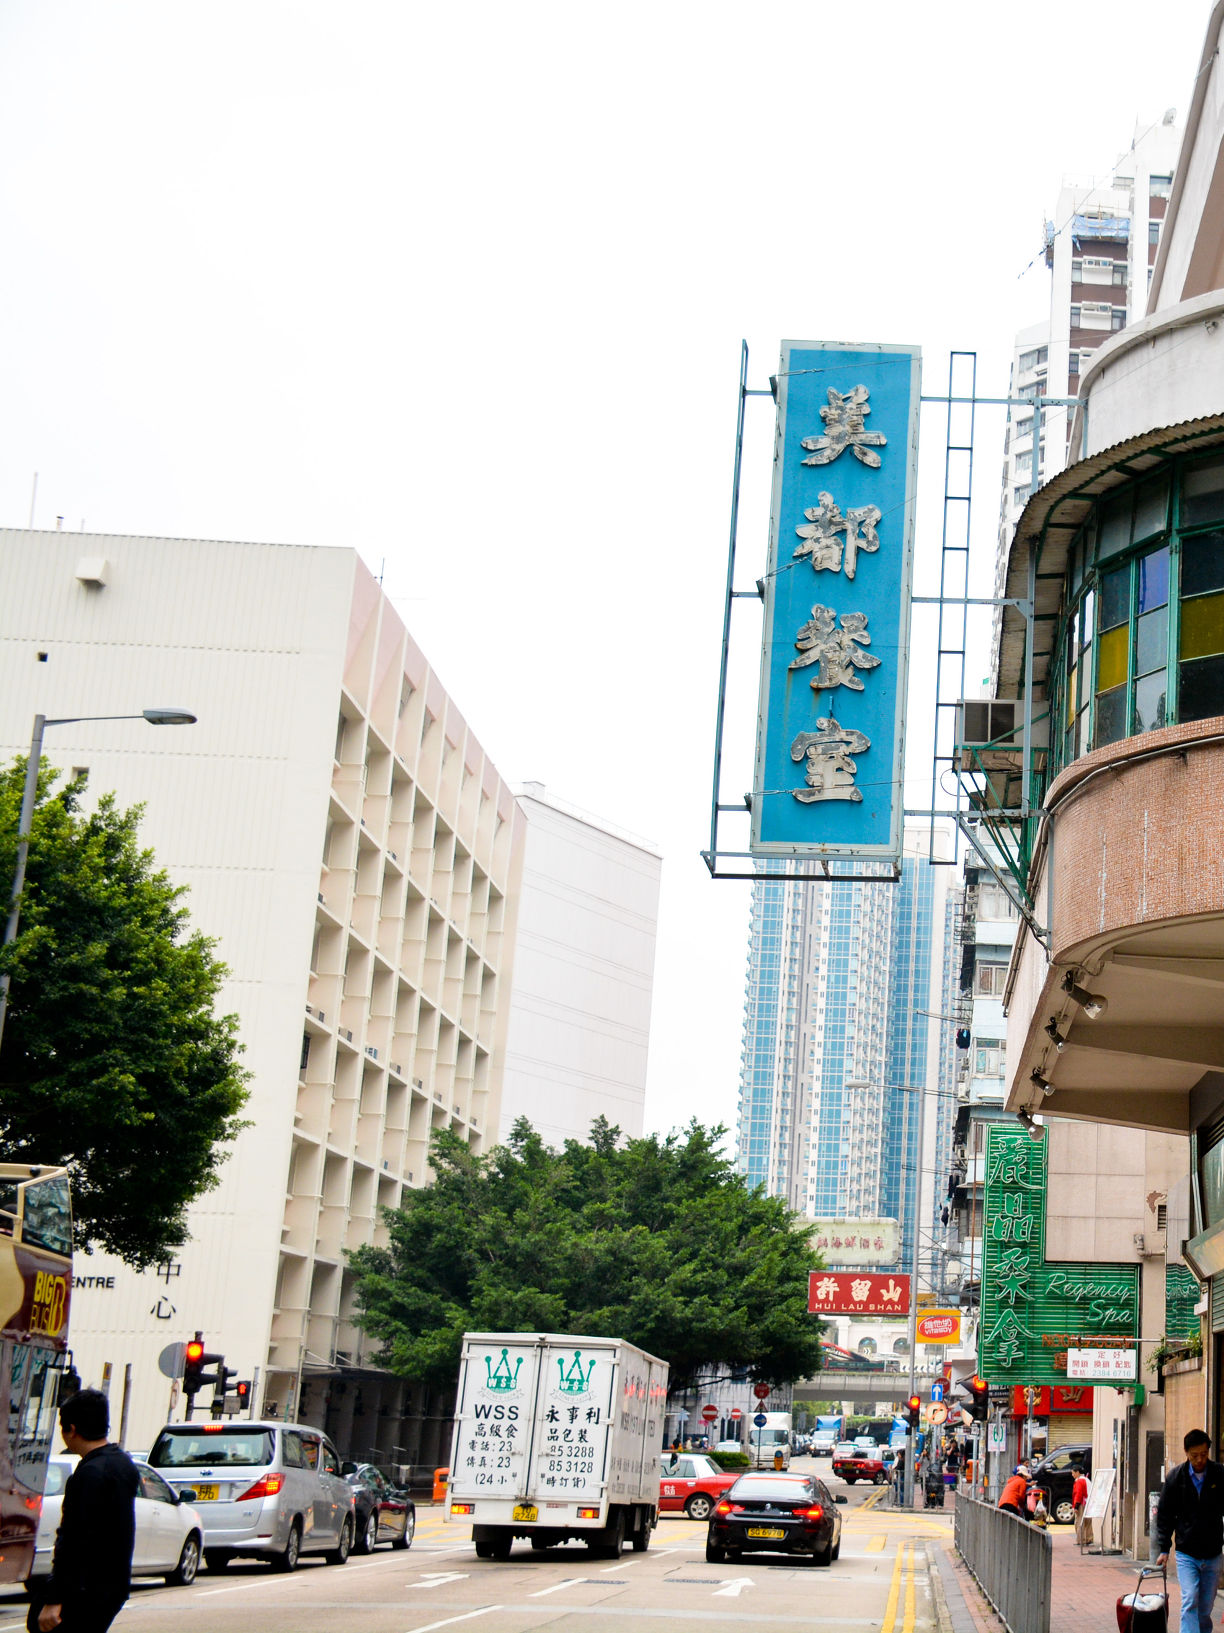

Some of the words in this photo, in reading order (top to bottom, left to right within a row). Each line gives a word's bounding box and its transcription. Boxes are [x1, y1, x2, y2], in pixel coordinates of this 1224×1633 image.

[788, 383, 887, 804] 美都餐室
[984, 1136, 1047, 1367] 麗晶桑拿
[34, 1271, 54, 1304] BIG
[816, 1277, 902, 1301] 許留山
[1044, 1273, 1132, 1302] Regency
[1087, 1299, 1133, 1328] Spa
[925, 1326, 953, 1335] VITASOY
[474, 1404, 519, 1420] WSS
[545, 1405, 600, 1425] 永事利
[475, 1423, 518, 1438] 高級食
[547, 1428, 589, 1443] 品包裝
[499, 1441, 513, 1452] 23
[567, 1446, 594, 1458] 3288
[497, 1456, 511, 1468] 23
[566, 1461, 594, 1473] 3128
